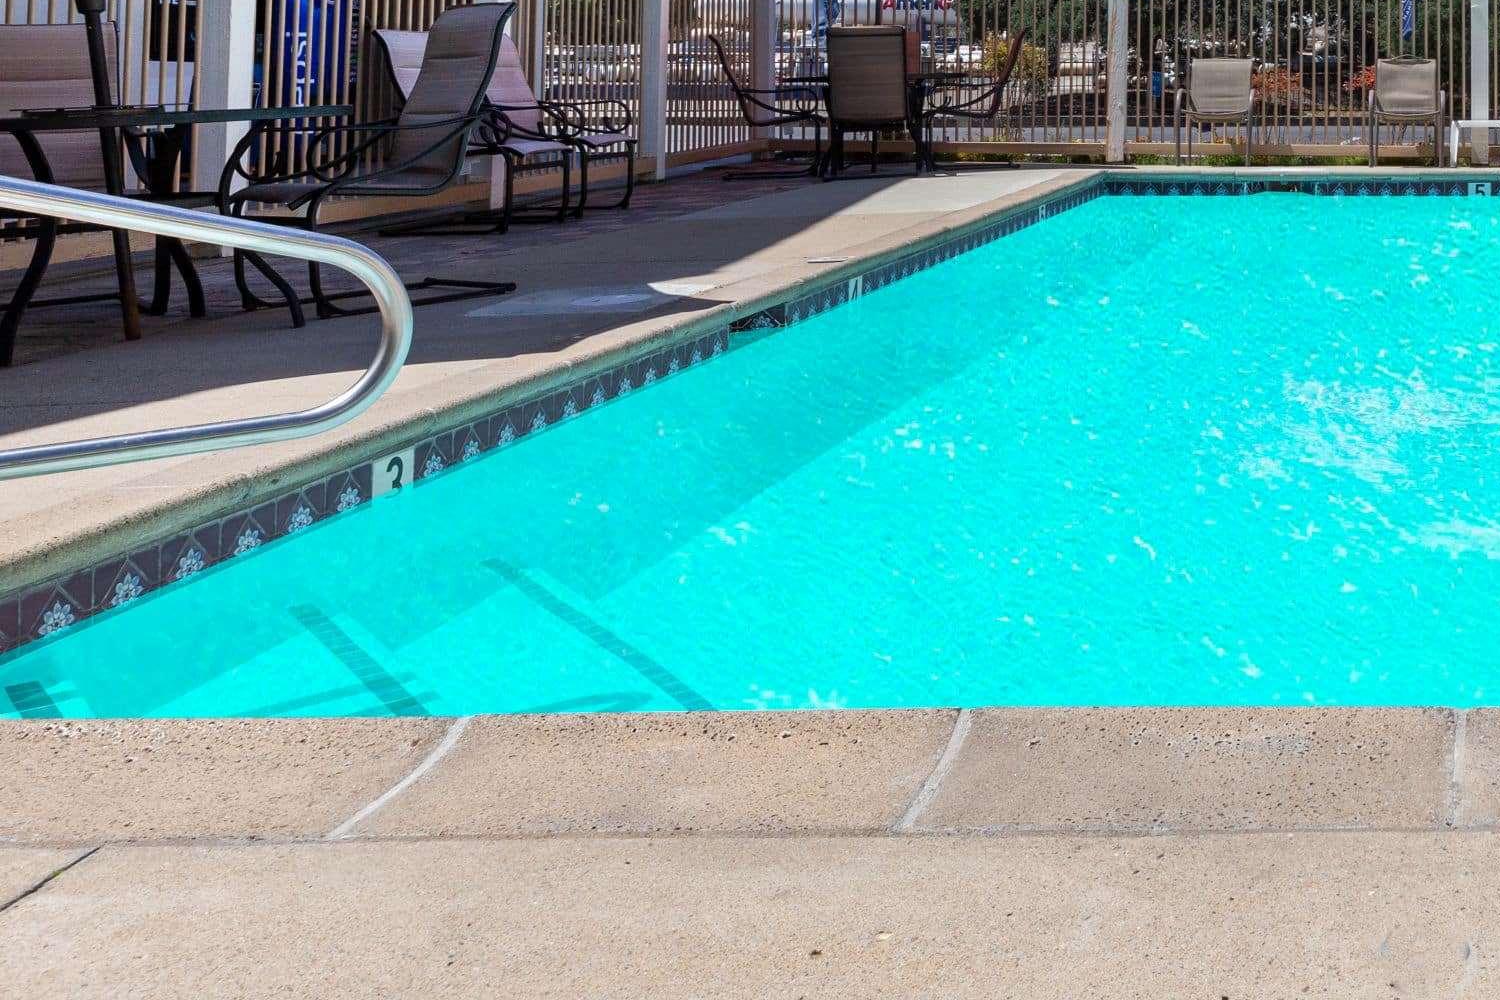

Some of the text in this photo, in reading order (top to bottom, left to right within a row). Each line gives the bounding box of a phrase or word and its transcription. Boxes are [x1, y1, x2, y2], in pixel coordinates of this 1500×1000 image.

[285, 31, 316, 135] epsi
[1475, 183, 1486, 197] 5
[385, 456, 404, 491] 3
